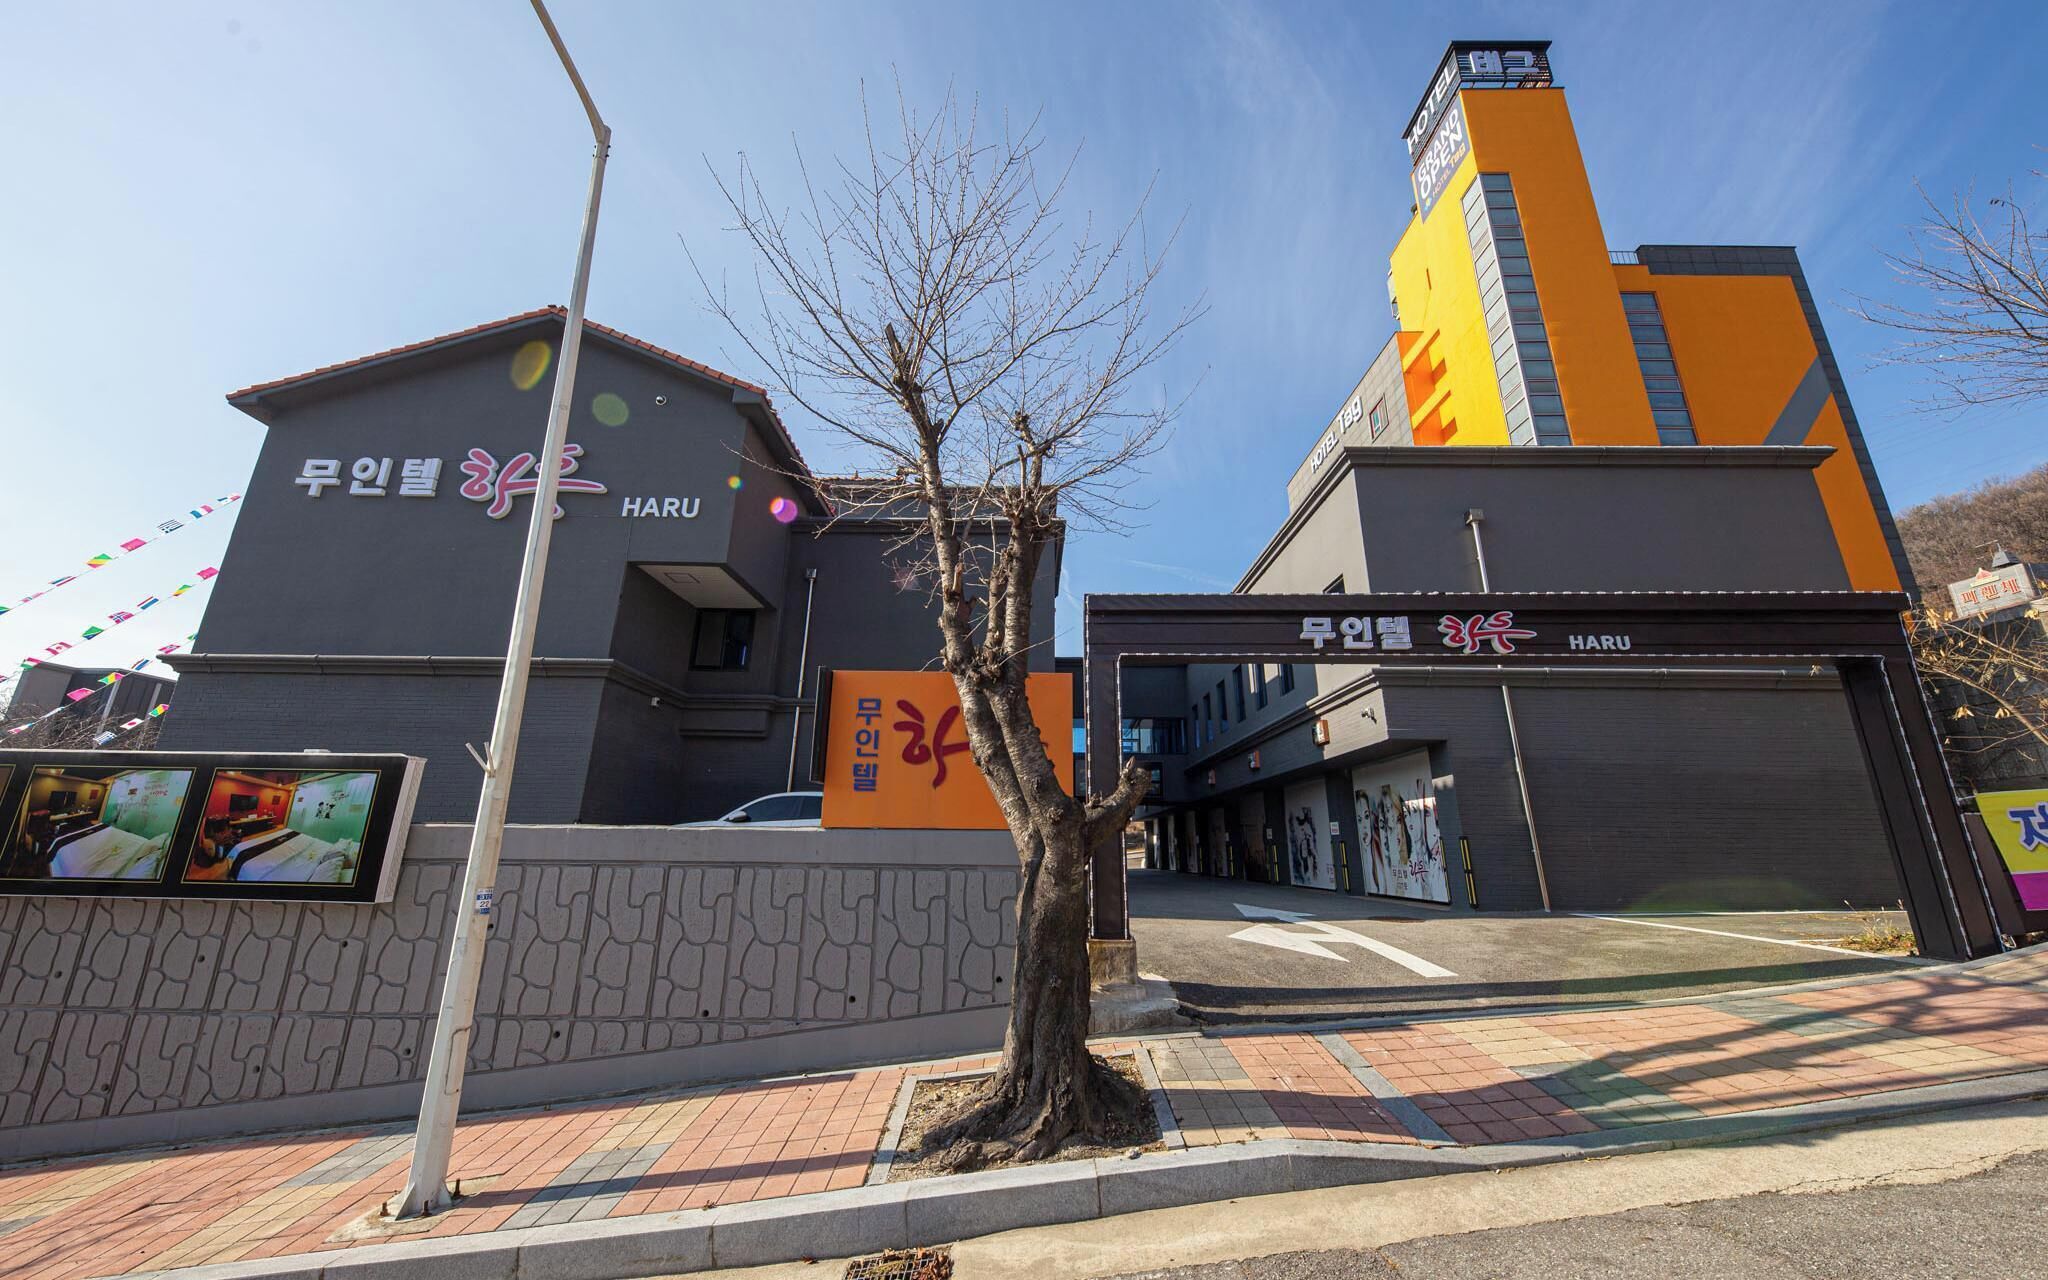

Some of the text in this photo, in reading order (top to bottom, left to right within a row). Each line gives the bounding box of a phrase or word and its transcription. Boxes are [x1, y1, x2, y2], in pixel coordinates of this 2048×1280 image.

[1407, 62, 1458, 155] HOTEL
[1417, 108, 1459, 183] GRAND
[1420, 121, 1463, 199] OPEN
[1432, 168, 1451, 197] HOTEL
[1311, 395, 1363, 474] HOTEL Tag
[294, 456, 443, 498] 무인텔
[621, 496, 701, 519] HARU
[1299, 616, 1413, 650] 무인텔
[1568, 634, 1632, 651] HARU
[852, 697, 882, 792] 무인텔
